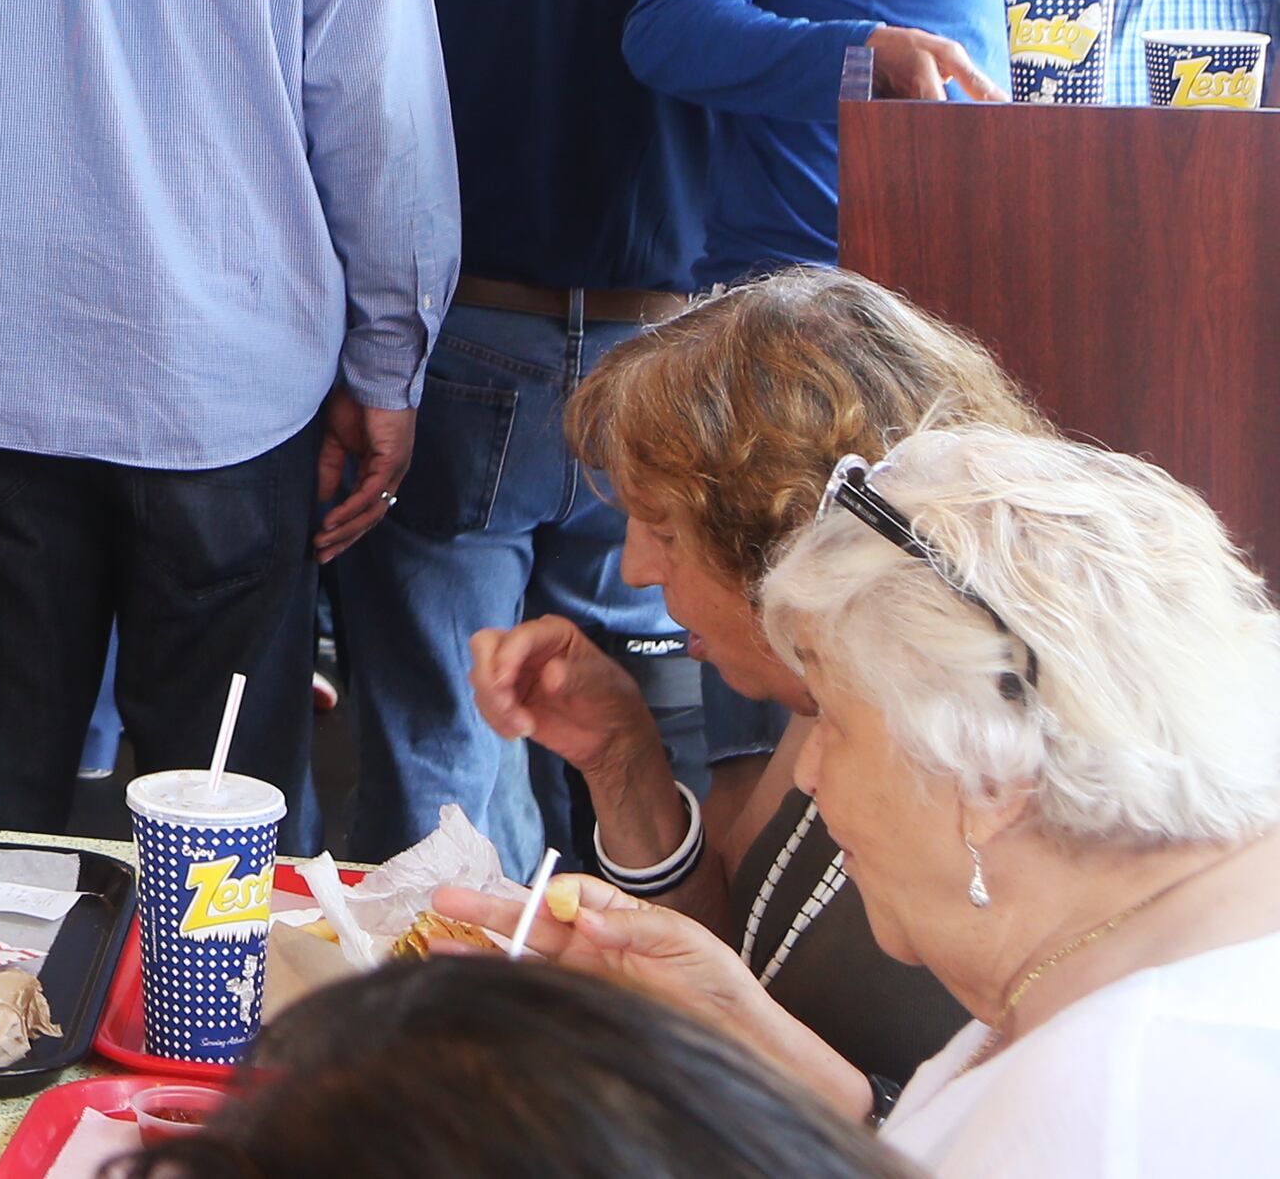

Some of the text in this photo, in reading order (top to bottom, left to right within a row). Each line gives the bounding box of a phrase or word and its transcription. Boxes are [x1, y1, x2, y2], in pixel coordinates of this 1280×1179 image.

[1007, 4, 1082, 60] Zesto
[1172, 57, 1257, 108] Zesto
[181, 843, 217, 861] Enjoy
[181, 856, 271, 934] Zest
